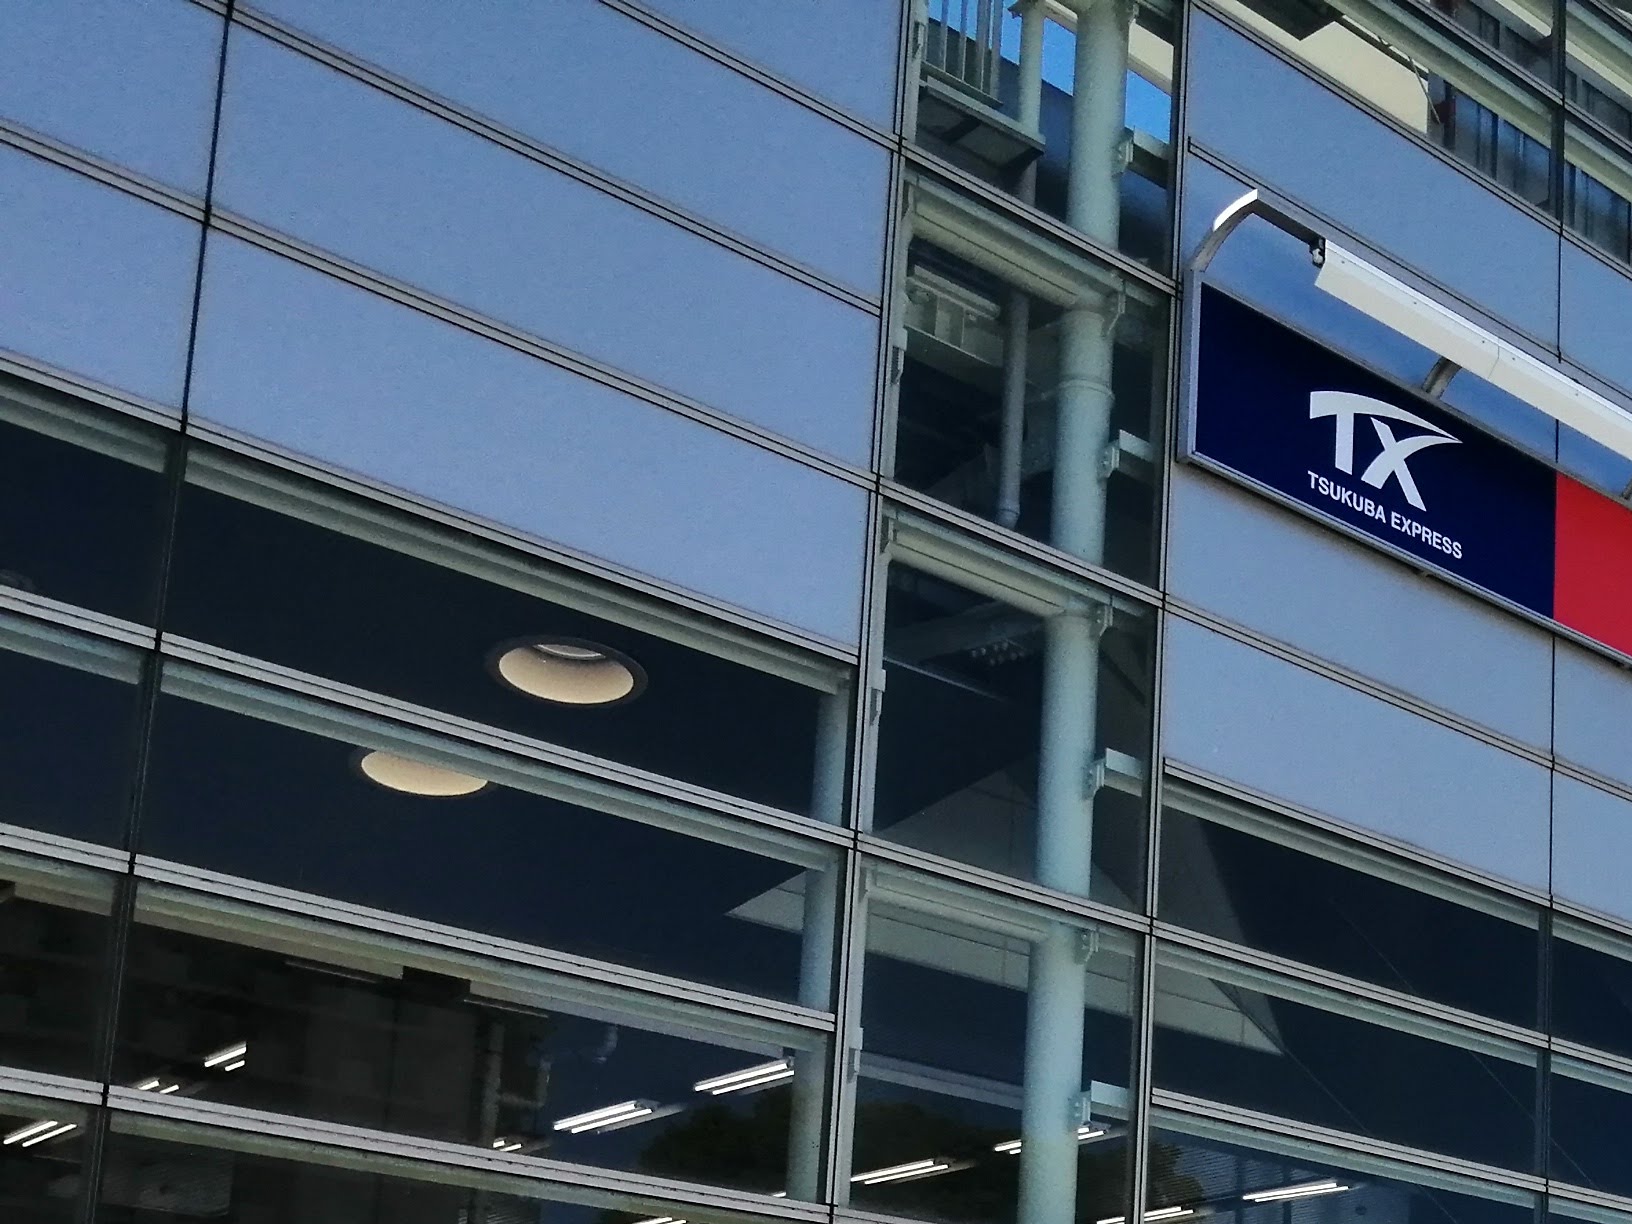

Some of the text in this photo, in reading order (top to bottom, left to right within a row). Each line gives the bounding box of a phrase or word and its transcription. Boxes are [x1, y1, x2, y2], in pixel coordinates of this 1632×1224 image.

[1309, 391, 1463, 512] TX
[1308, 470, 1463, 560] TSUKUBA EXPRESS
